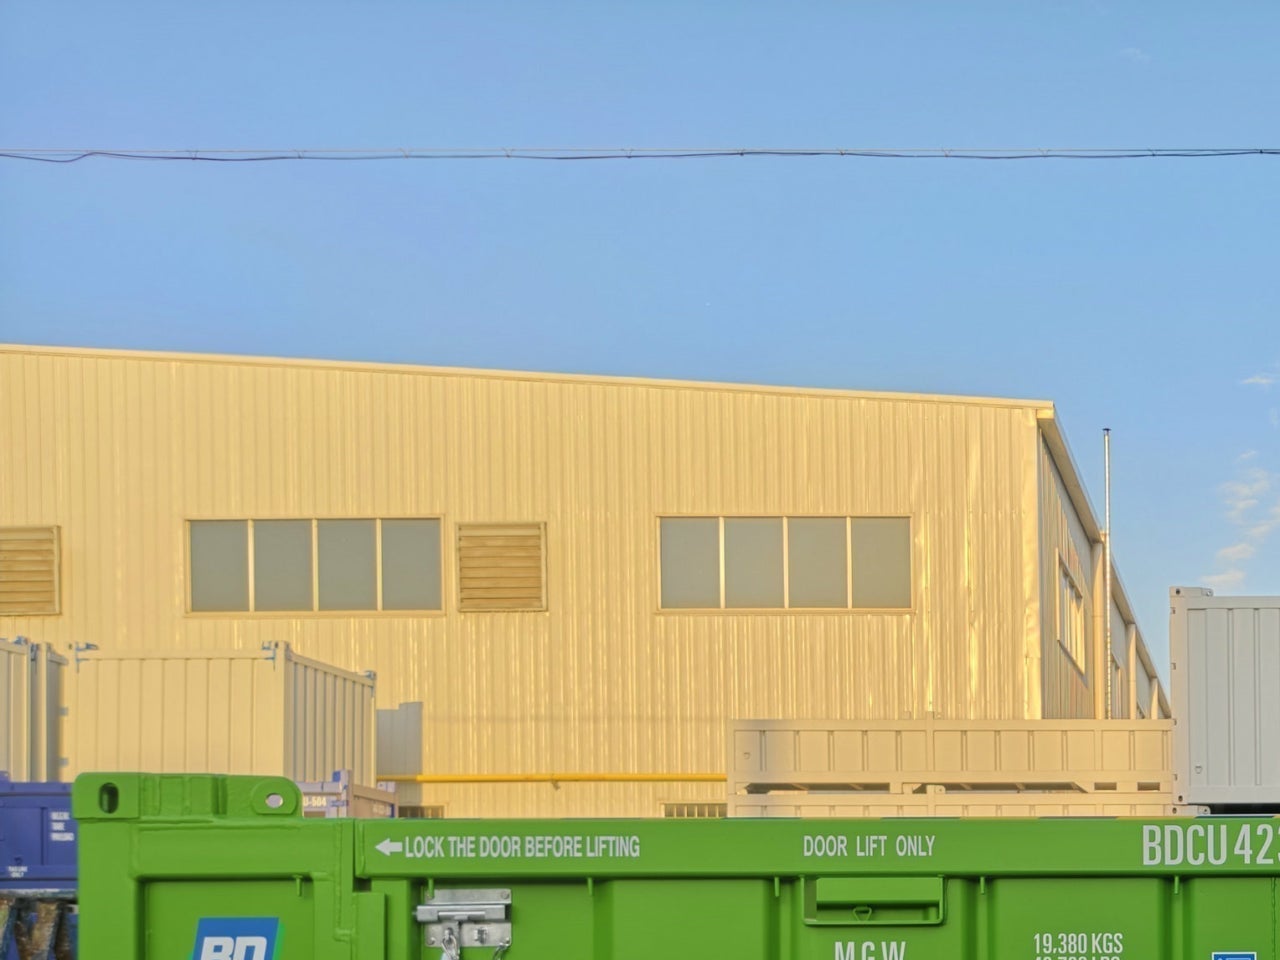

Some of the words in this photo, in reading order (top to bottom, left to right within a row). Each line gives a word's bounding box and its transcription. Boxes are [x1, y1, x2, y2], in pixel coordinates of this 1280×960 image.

[405, 835, 445, 858] LOCK
[447, 836, 476, 858] THE
[479, 835, 521, 858] DOOR
[524, 835, 583, 858] BEFORE
[586, 835, 640, 858] LIFTING
[803, 835, 848, 857] DOOR
[856, 835, 888, 857] LIFT
[895, 835, 935, 857] ONLY
[1142, 824, 1228, 866] BDCU
[1033, 932, 1088, 955] 19,380
[1091, 932, 1124, 954] KGS
